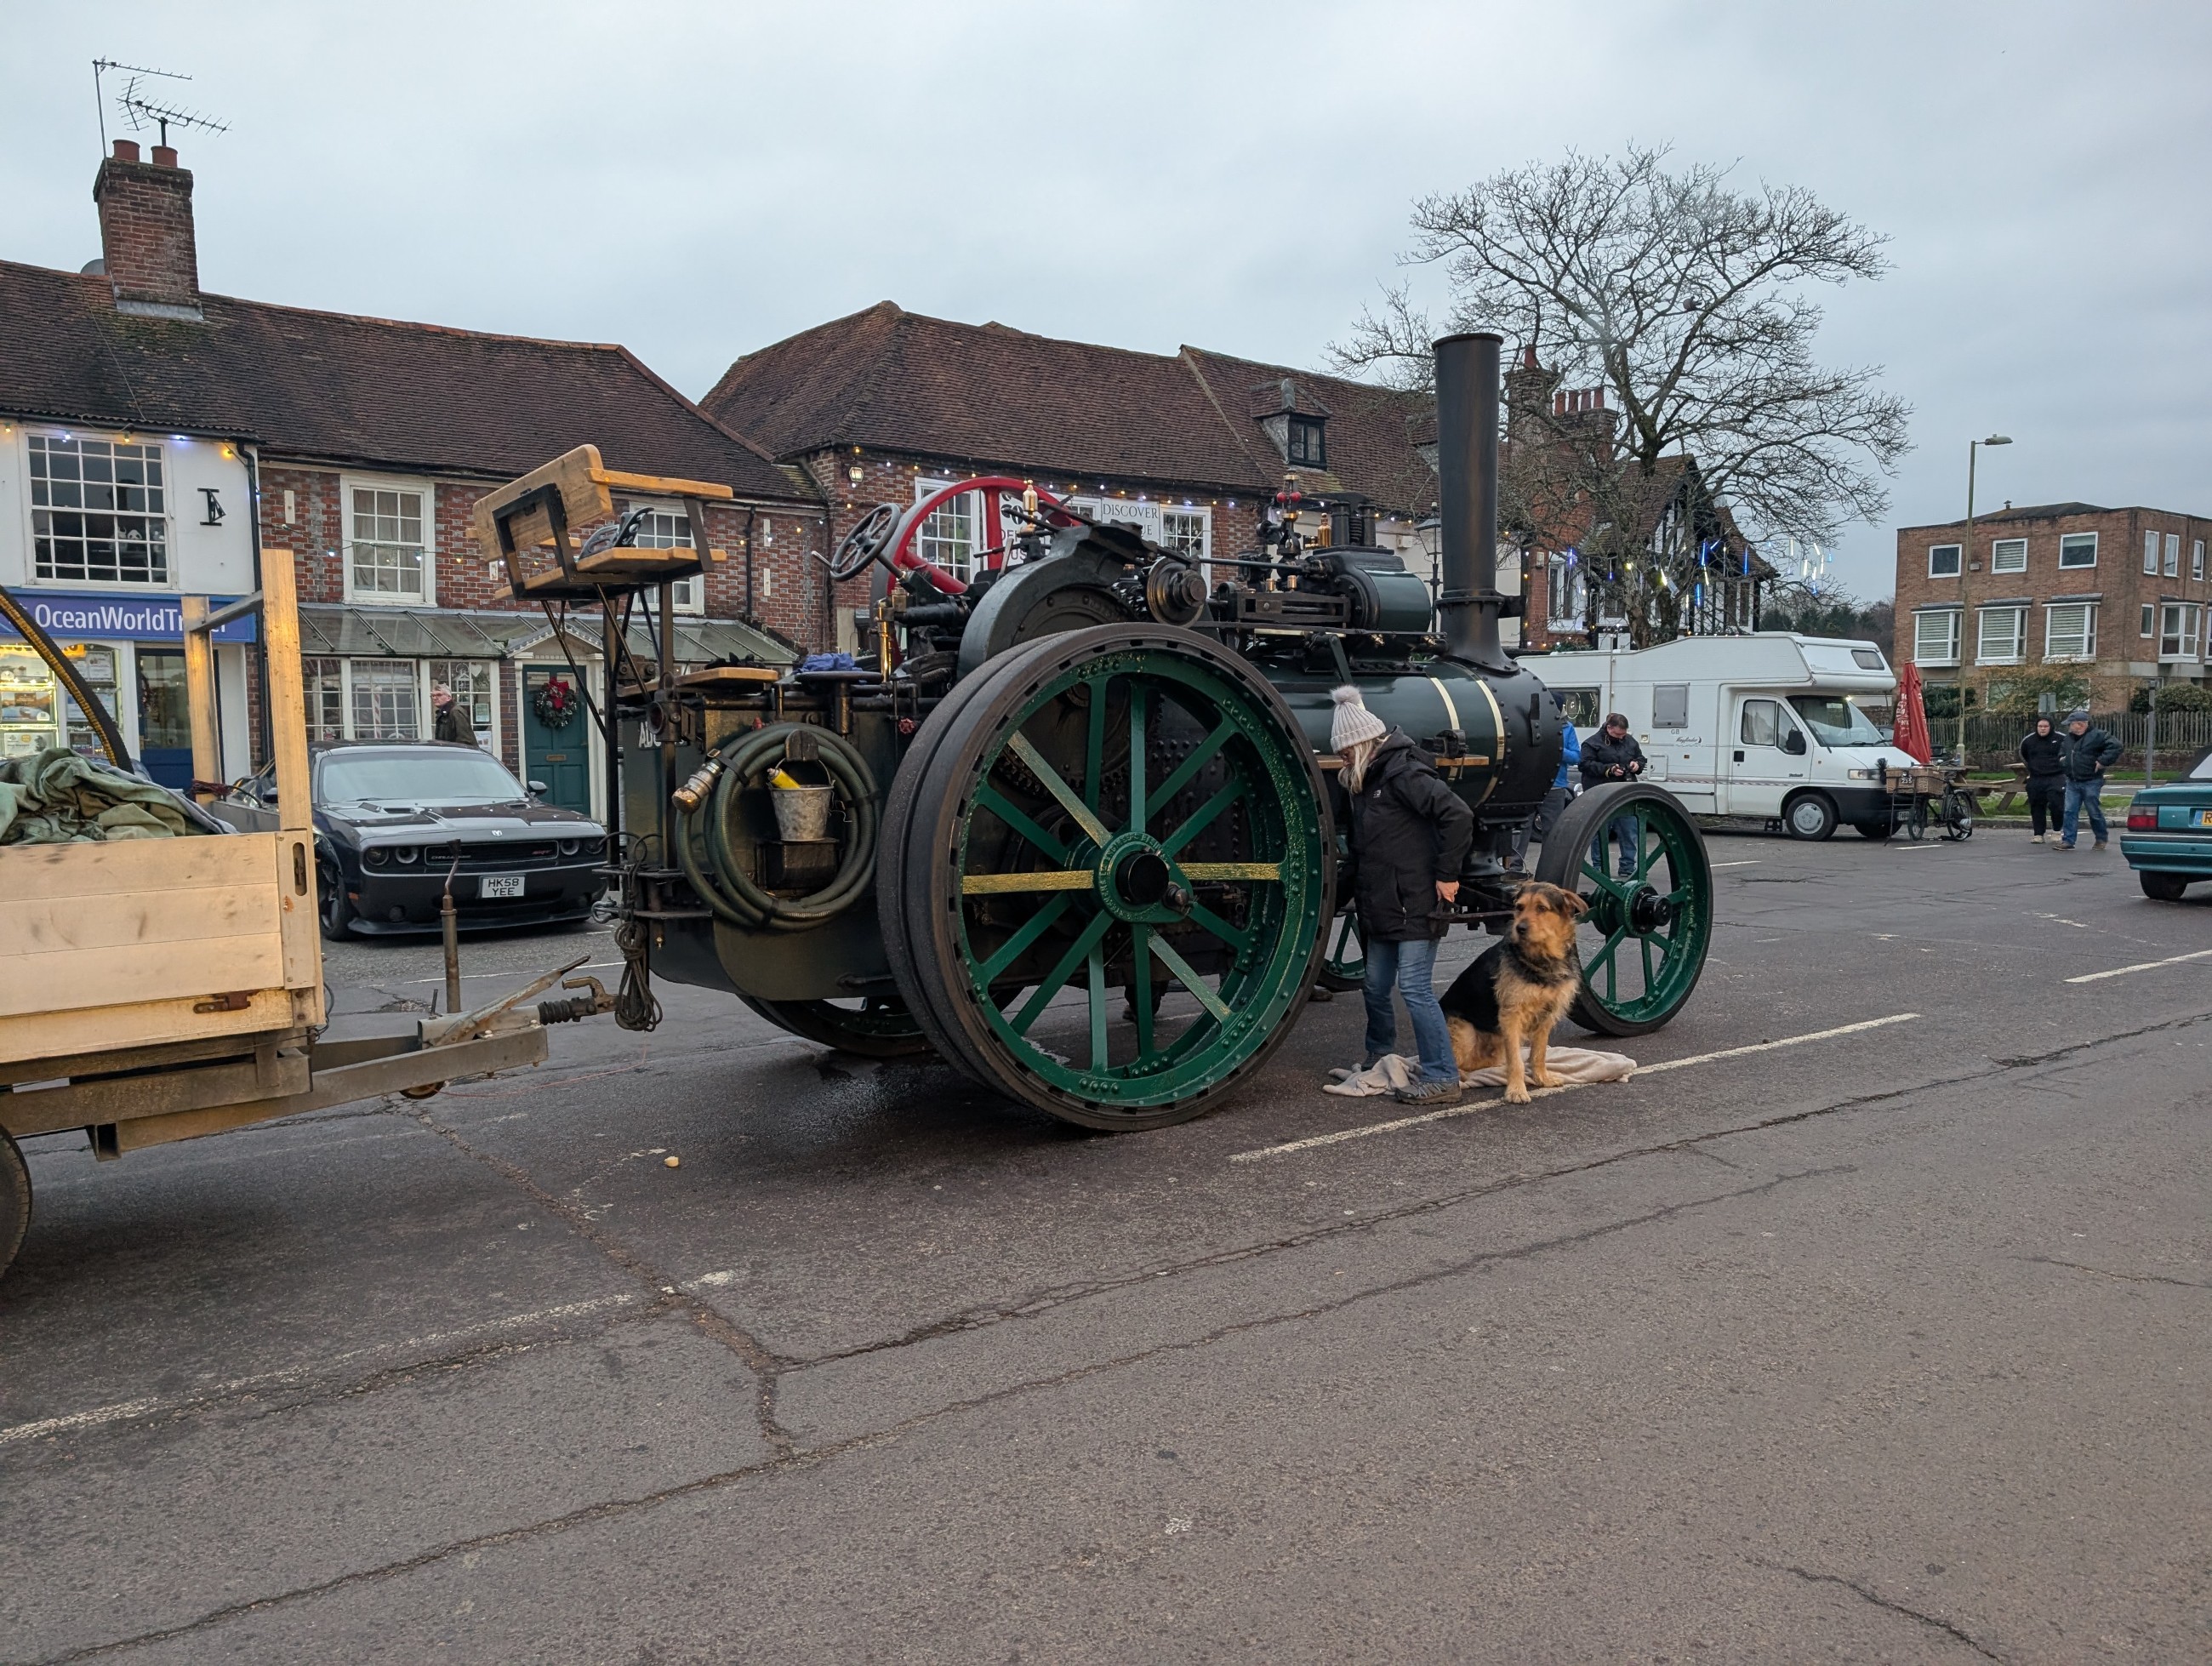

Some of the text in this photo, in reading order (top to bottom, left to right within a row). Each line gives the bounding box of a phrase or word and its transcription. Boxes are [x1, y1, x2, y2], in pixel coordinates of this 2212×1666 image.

[1103, 503, 1159, 519] DISCOVER
[35, 603, 226, 634] OceanWorldTr
[487, 878, 519, 887] HK58
[492, 887, 515, 896] YEE
